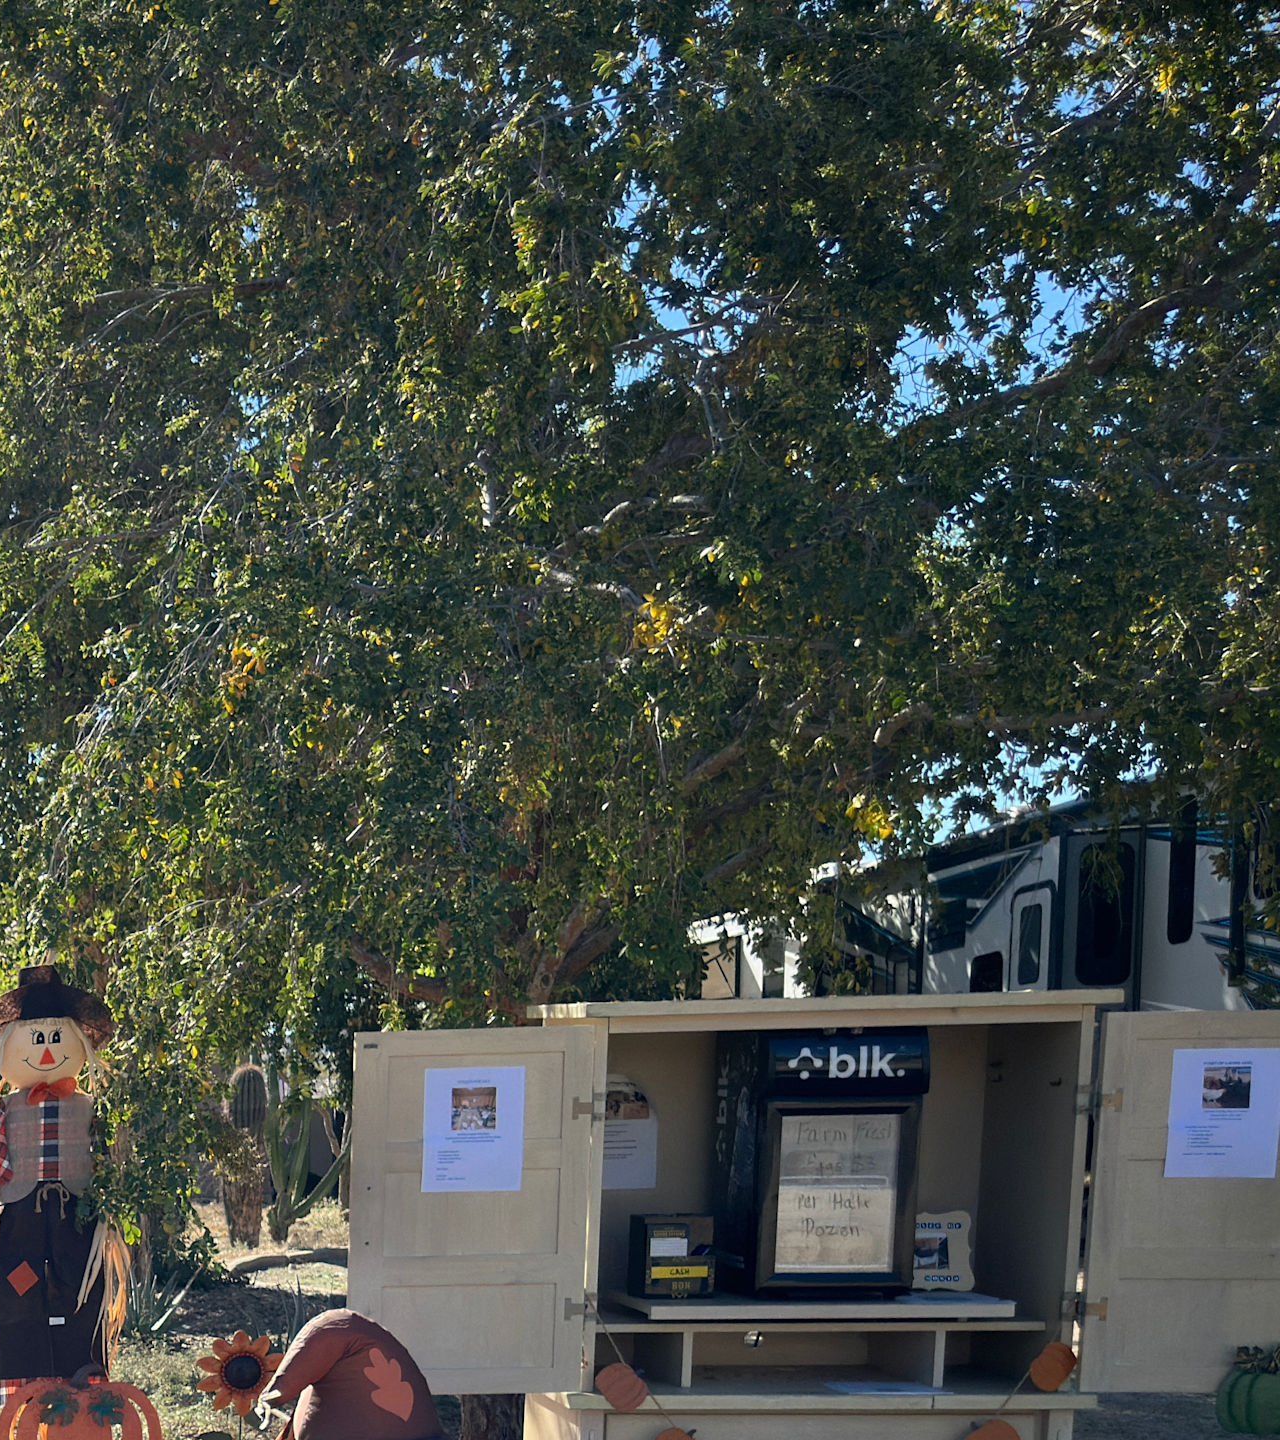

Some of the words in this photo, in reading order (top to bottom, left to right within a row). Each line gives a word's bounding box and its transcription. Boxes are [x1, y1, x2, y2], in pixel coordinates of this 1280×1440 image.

[828, 1045, 905, 1079] blk.
[797, 1121, 847, 1145] Farm
[802, 1217, 860, 1238] Dozen
[670, 1268, 690, 1276] CASH
